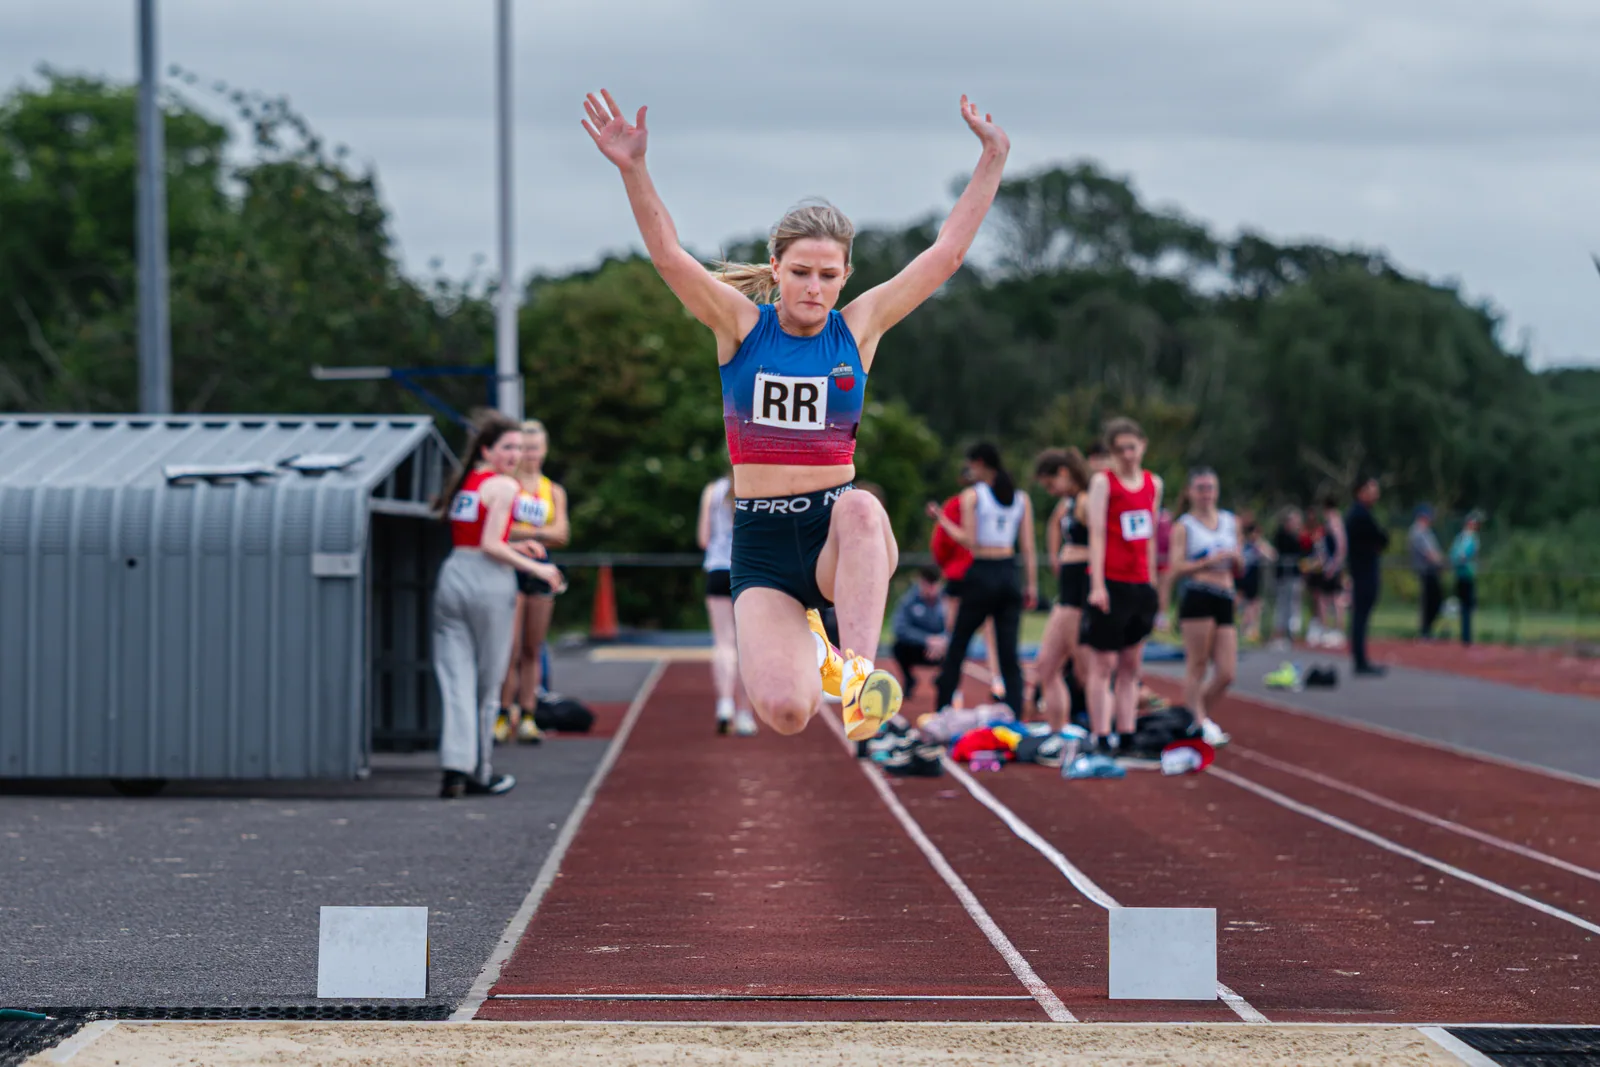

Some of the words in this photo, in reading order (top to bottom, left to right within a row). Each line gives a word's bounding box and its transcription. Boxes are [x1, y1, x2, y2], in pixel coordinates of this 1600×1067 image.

[762, 380, 818, 422] RR
[455, 495, 473, 513] P
[752, 497, 811, 514] PRO
